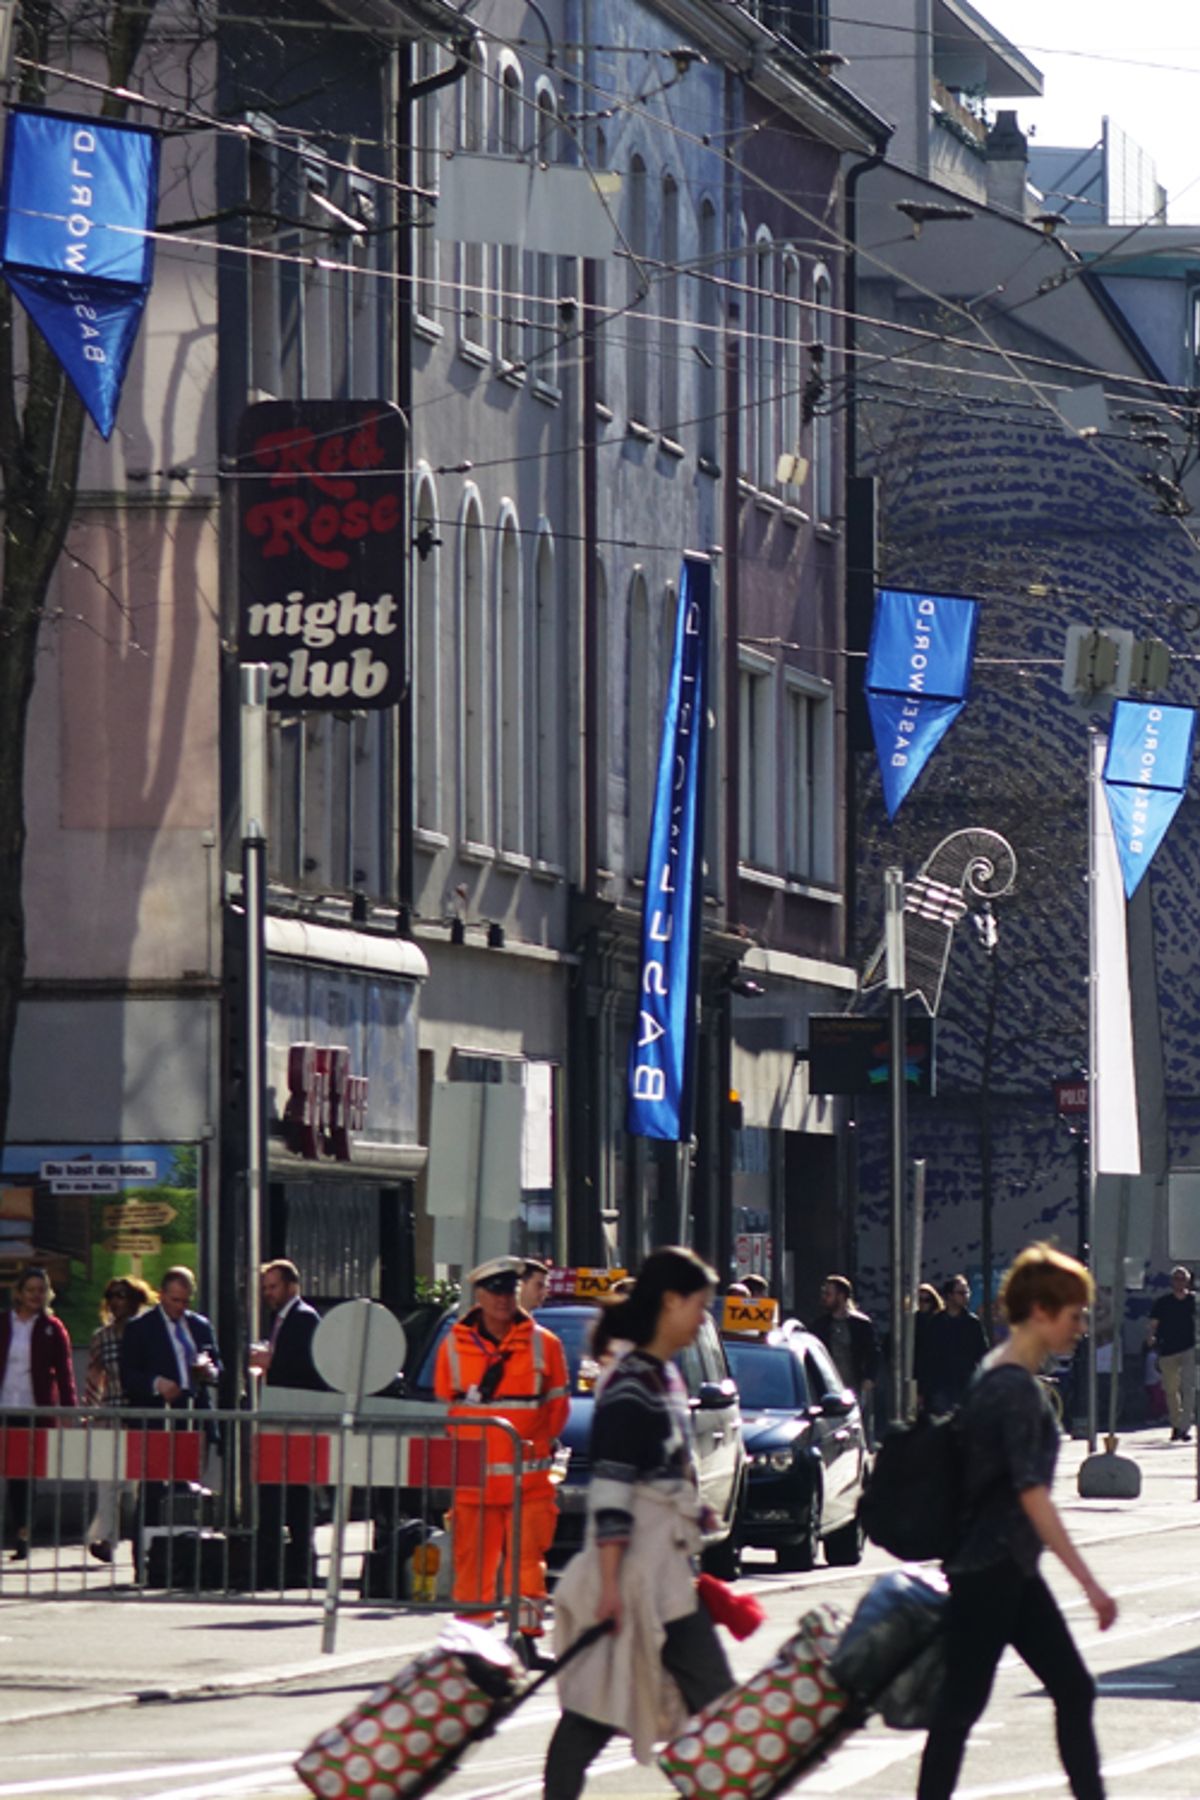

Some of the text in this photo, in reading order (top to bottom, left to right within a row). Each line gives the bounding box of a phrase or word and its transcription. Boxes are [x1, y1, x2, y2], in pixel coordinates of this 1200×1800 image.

[255, 410, 386, 498] Red
[245, 495, 399, 570] Rose
[247, 590, 398, 648] night
[267, 648, 389, 699] club
[1060, 1088, 1088, 1105] POLIZ
[727, 1305, 773, 1322] TAXI
